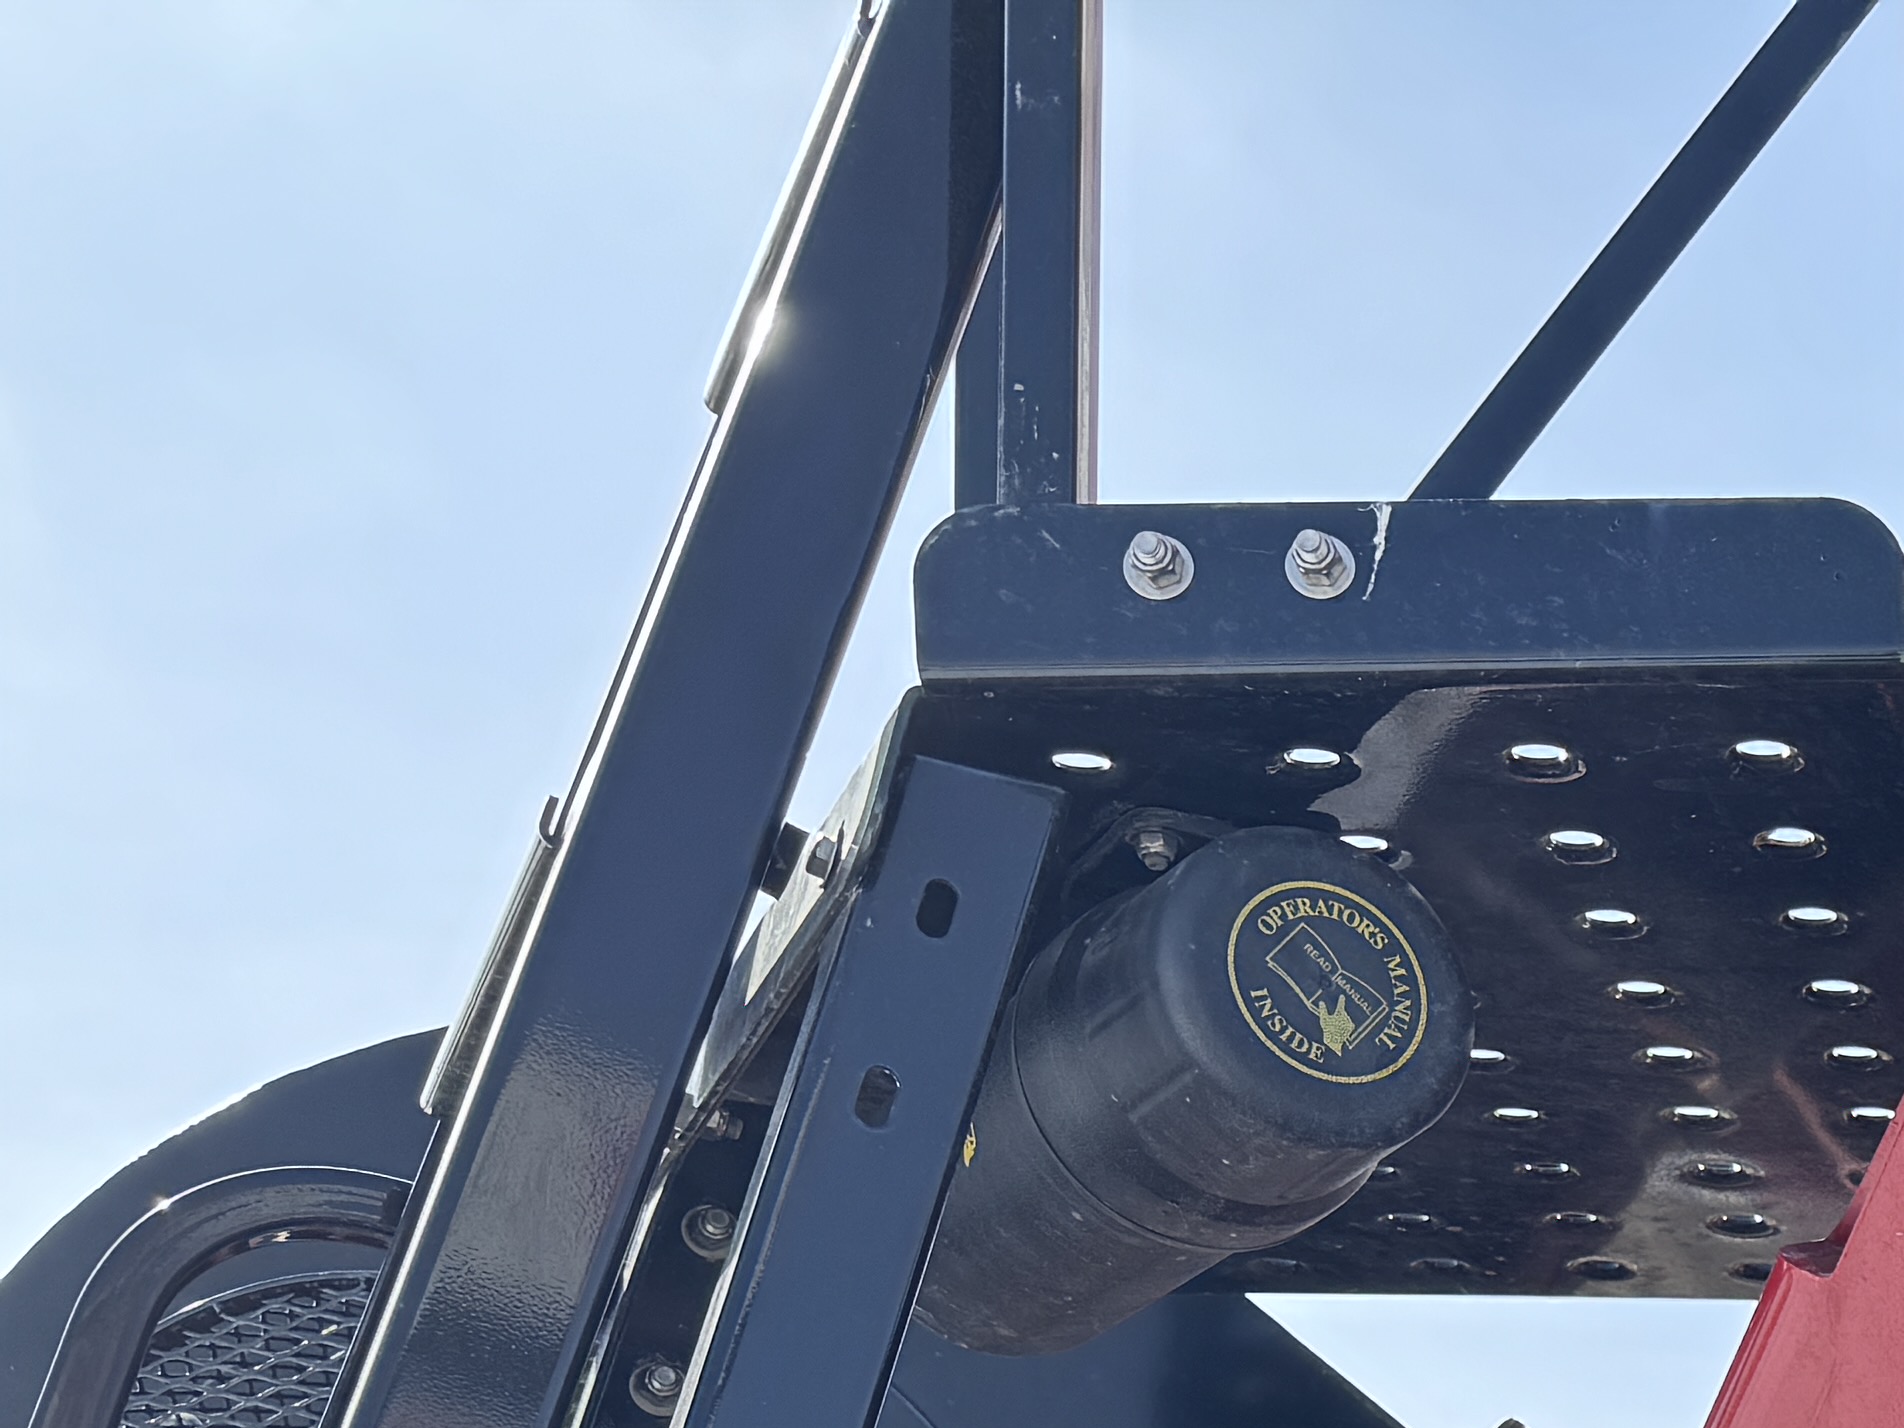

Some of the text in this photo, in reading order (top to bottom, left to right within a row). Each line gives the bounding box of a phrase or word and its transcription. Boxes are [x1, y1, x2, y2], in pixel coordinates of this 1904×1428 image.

[1257, 897, 1411, 1051] OPERATOR'S MANUAL
[1303, 943, 1332, 973] READ
[1250, 987, 1325, 1064] INSIDE
[1336, 978, 1373, 1016] MANUAL
